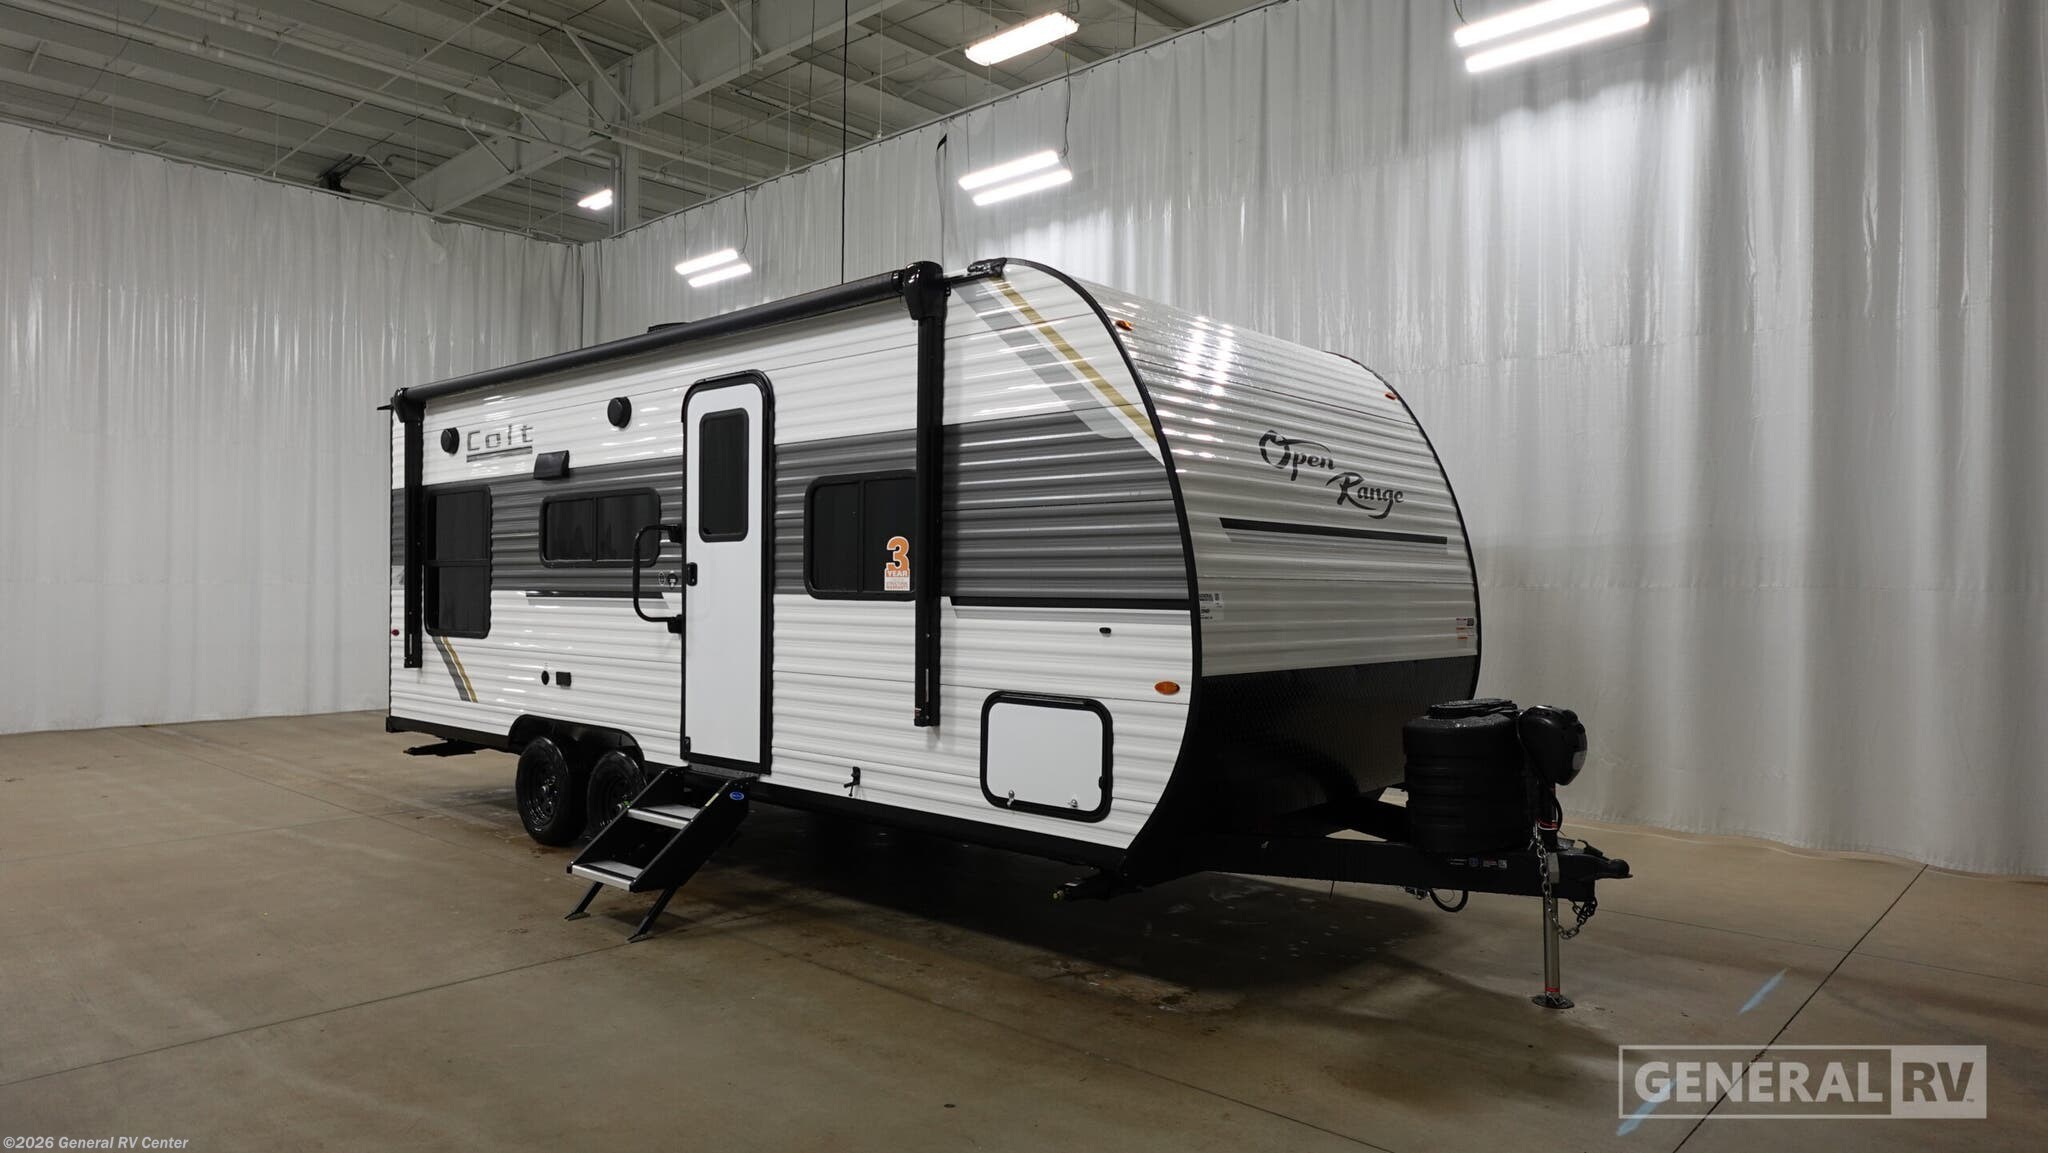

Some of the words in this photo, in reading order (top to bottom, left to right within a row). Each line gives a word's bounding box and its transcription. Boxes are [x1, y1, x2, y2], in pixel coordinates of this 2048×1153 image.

[467, 424, 533, 451] Colt
[1258, 429, 1336, 482] Open
[1325, 471, 1404, 520] Range
[887, 536, 910, 571] 3
